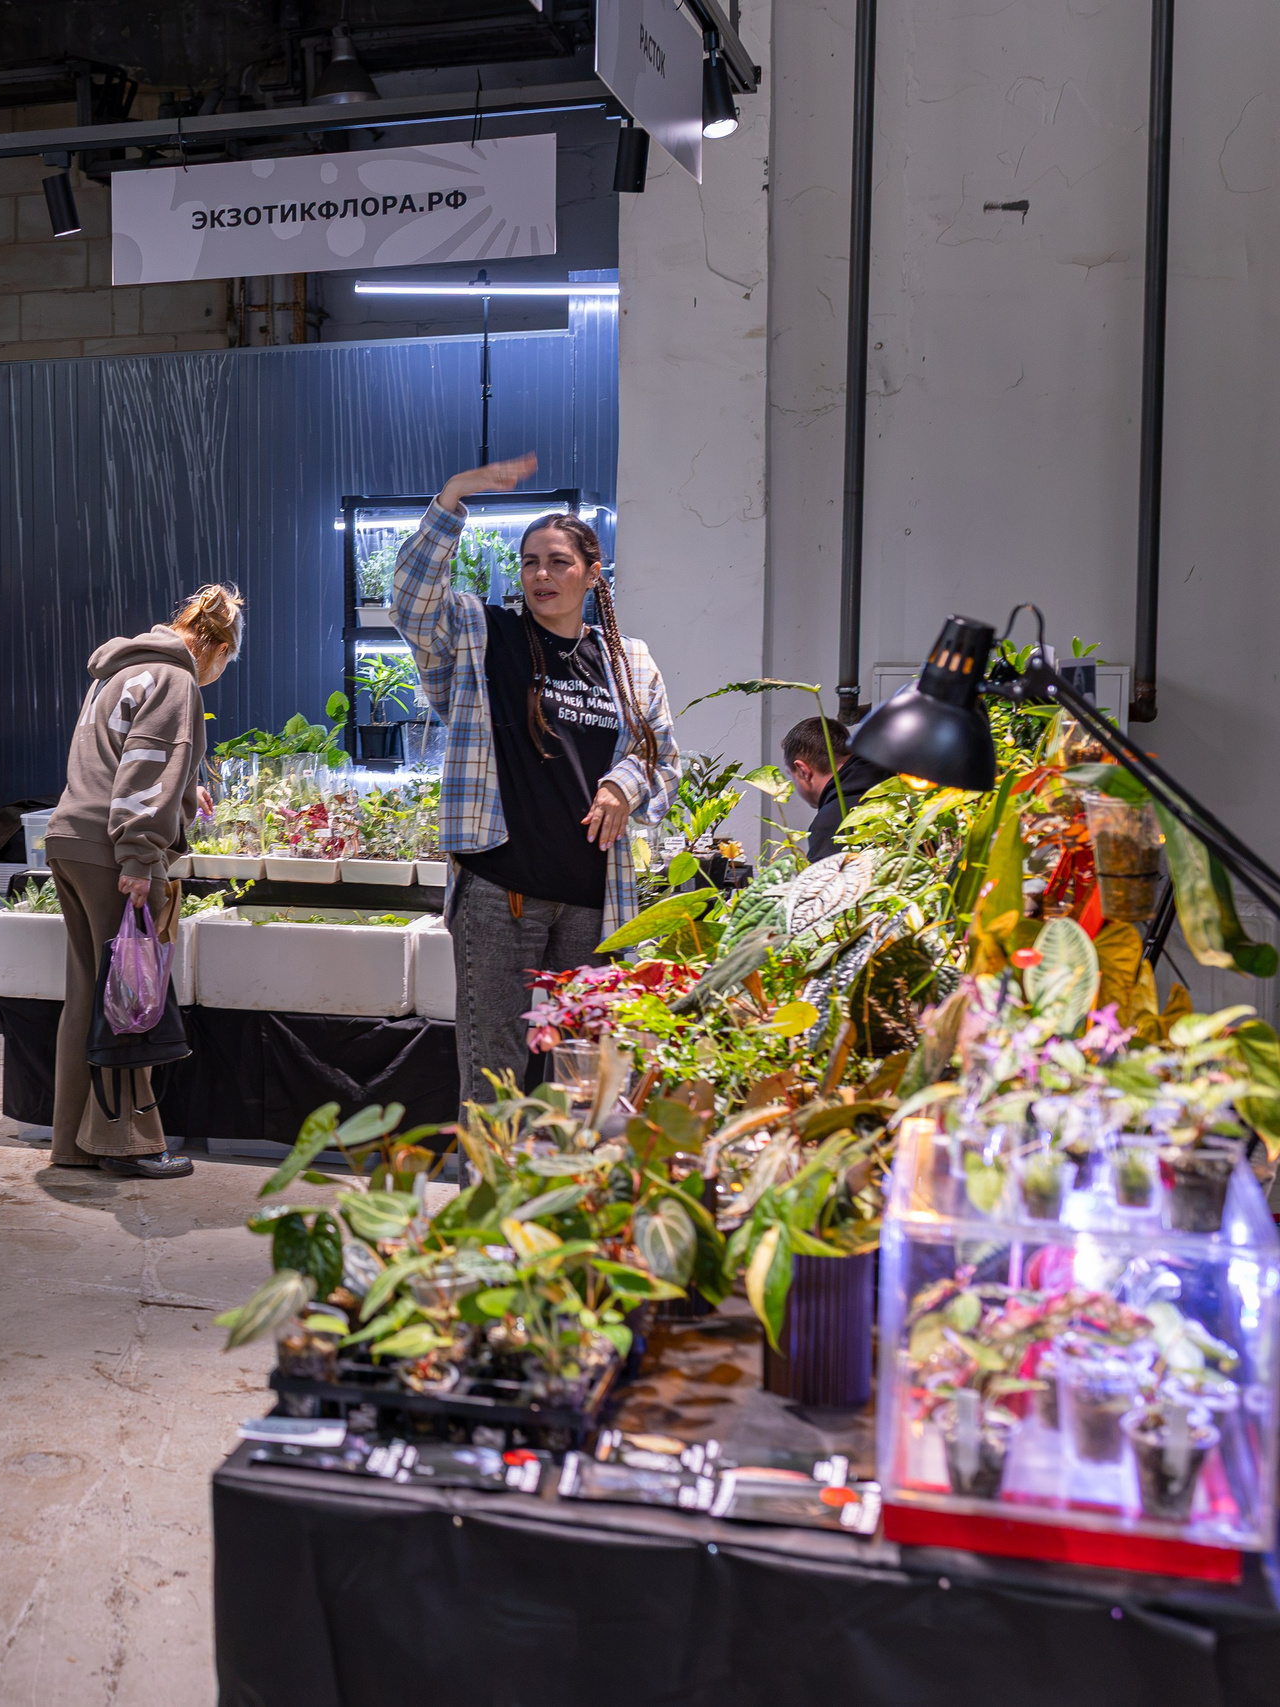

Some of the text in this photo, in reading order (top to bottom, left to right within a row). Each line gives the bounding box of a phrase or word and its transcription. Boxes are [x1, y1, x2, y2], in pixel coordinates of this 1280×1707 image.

[639, 23, 666, 79] РАСТОК
[191, 189, 468, 230] ЭКЗОТИКФЛОРА.РФ
[563, 694, 584, 709] НЕЙ
[558, 706, 619, 731] БЕЗ ГОРШКА
